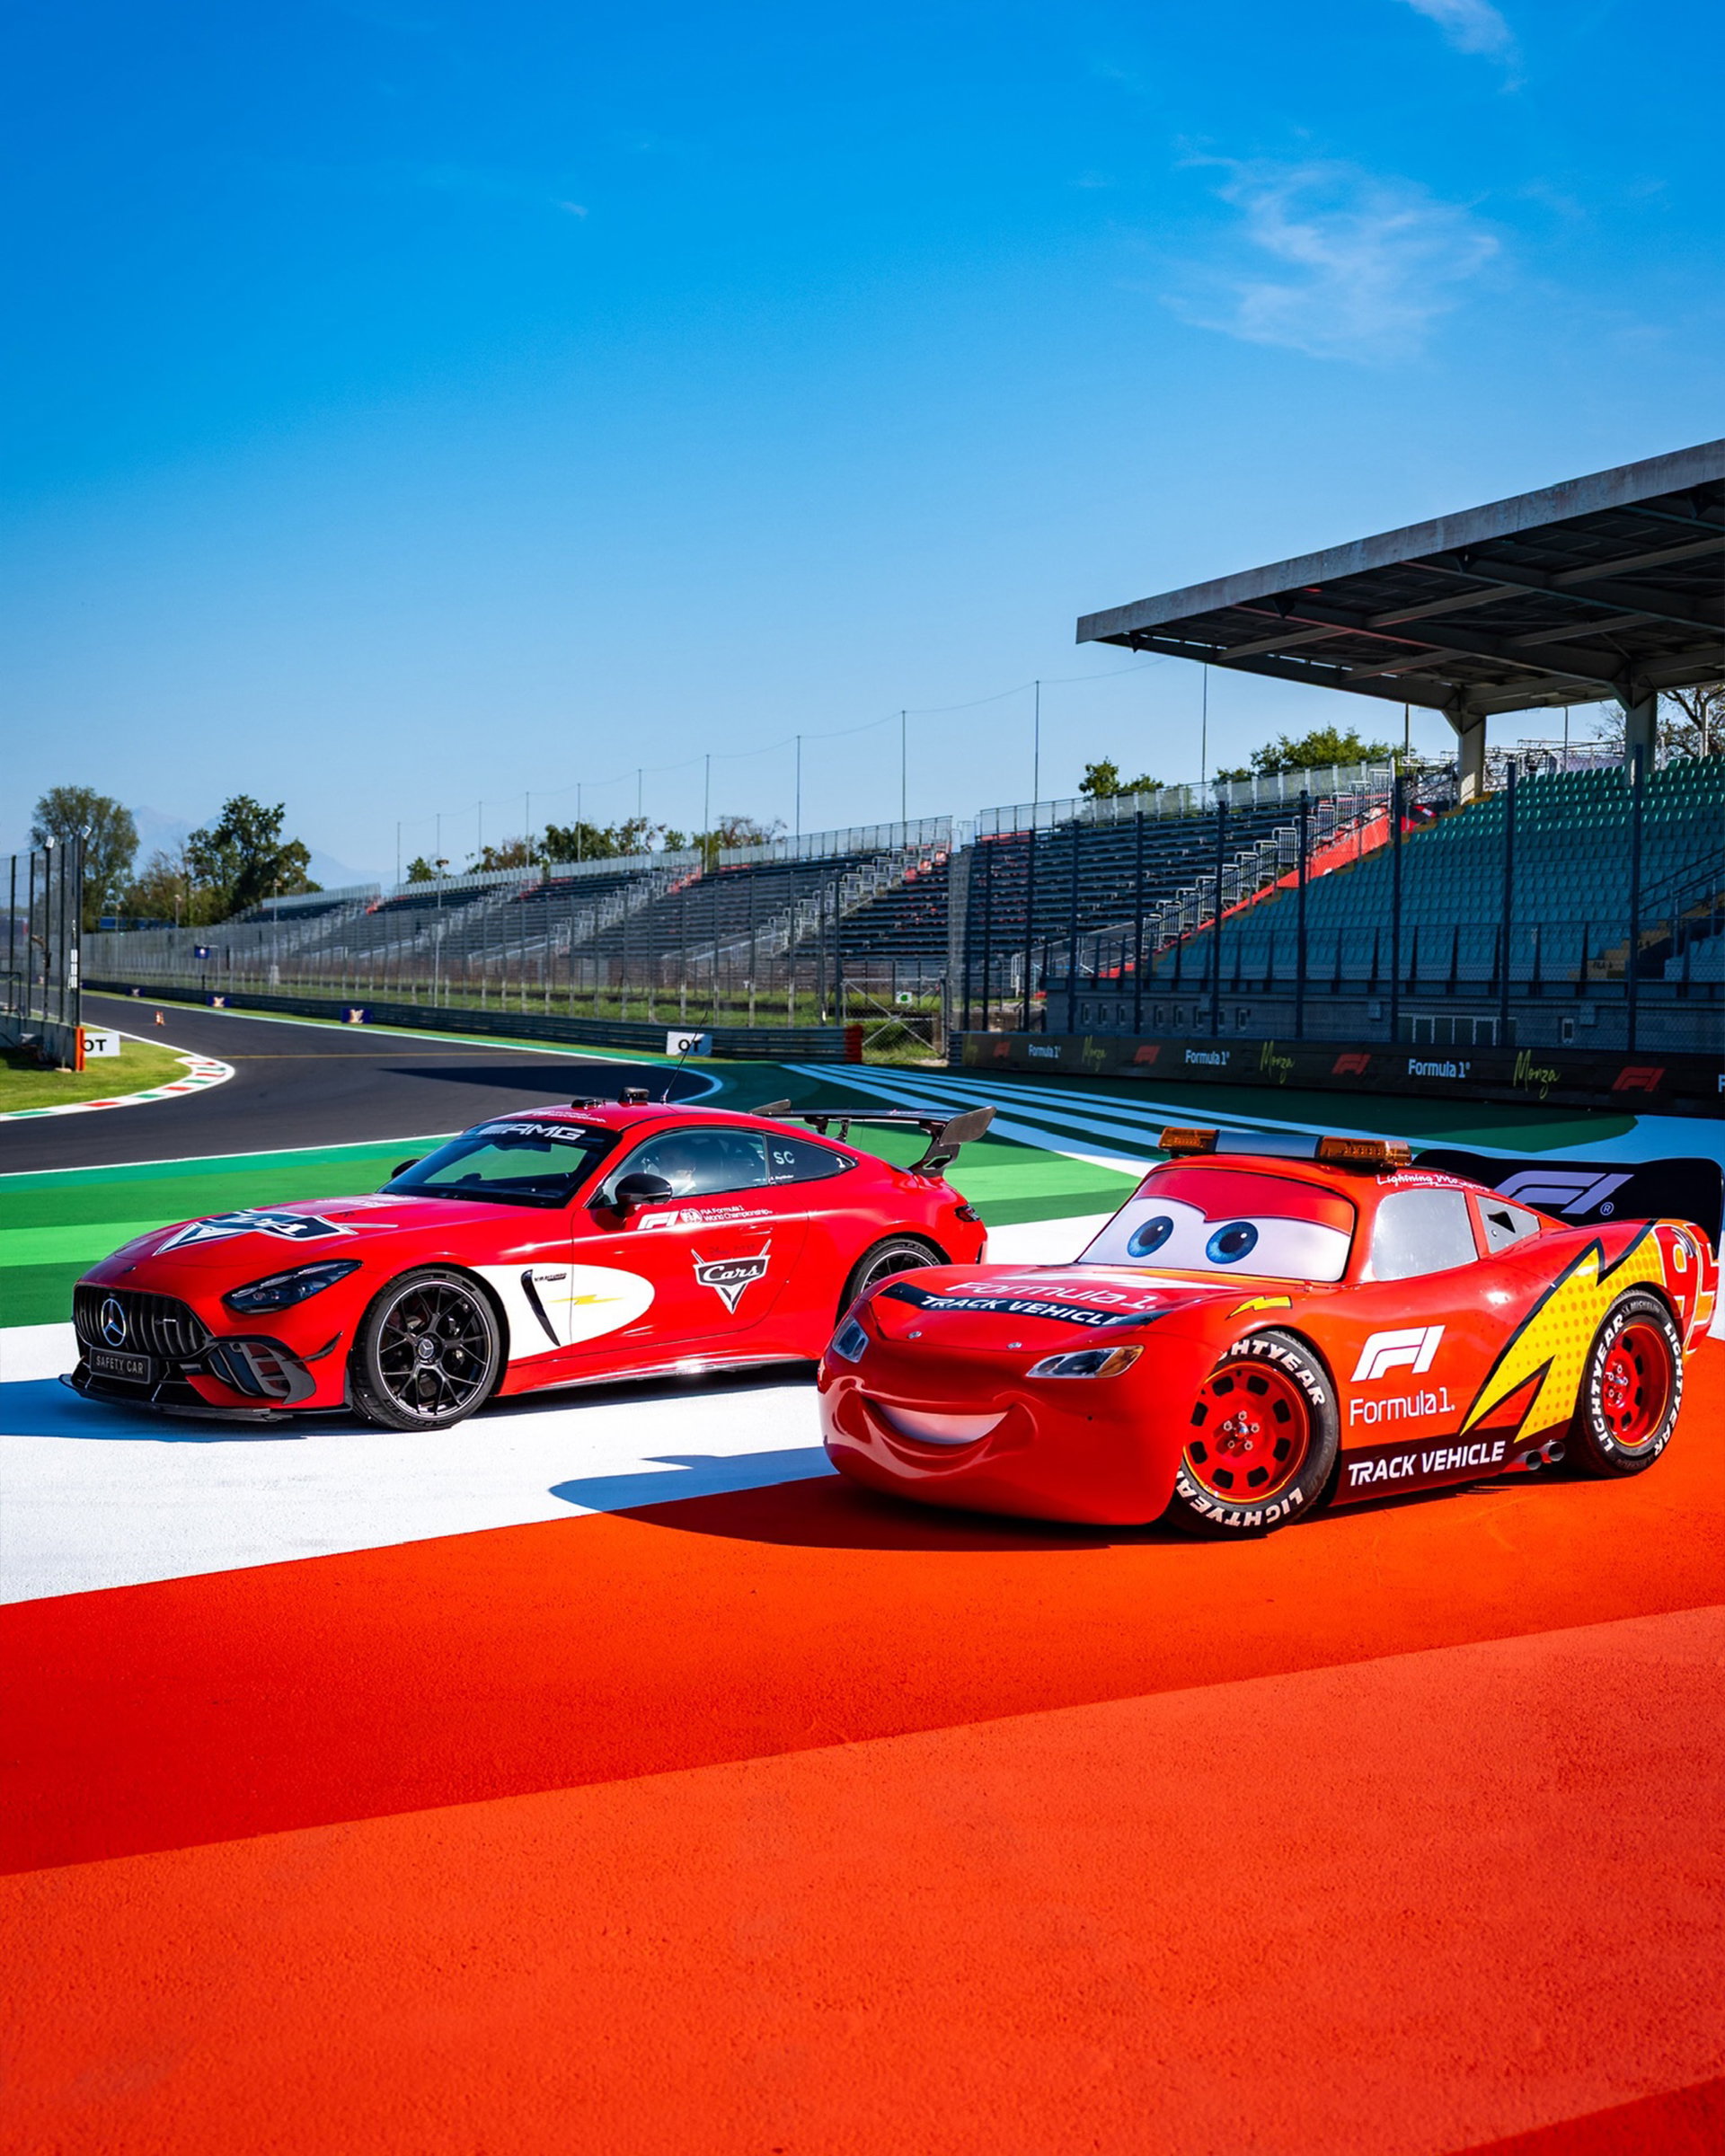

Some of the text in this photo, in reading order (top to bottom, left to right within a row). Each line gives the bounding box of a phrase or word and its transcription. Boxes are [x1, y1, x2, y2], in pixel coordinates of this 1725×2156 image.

[83, 1038, 107, 1052] OT
[677, 1038, 702, 1052] OT
[1028, 1044, 1054, 1057] Formula
[1185, 1049, 1220, 1065] Formula
[1261, 1039, 1296, 1084] Monza
[1408, 1058, 1456, 1078] Formula
[1513, 1049, 1561, 1100] Monza
[501, 1123, 586, 1141] AMG
[773, 1151, 795, 1165] SC
[836, 1157, 845, 1168] 1
[1376, 1173, 1434, 1188] Lightning
[703, 1264, 761, 1282] Cars
[945, 1281, 1121, 1304] Formula
[920, 1295, 1128, 1326] TRACK VEHICLE
[95, 1355, 144, 1374] SAFETY CAR
[1590, 1313, 1624, 1452] LIGHTYEAR
[1654, 1322, 1684, 1456] LIGHTYEAR
[1349, 1389, 1438, 1427] Formula
[1348, 1440, 1507, 1487] TRACK VEHICLE
[1176, 1471, 1304, 1527] LIGHTYEA
